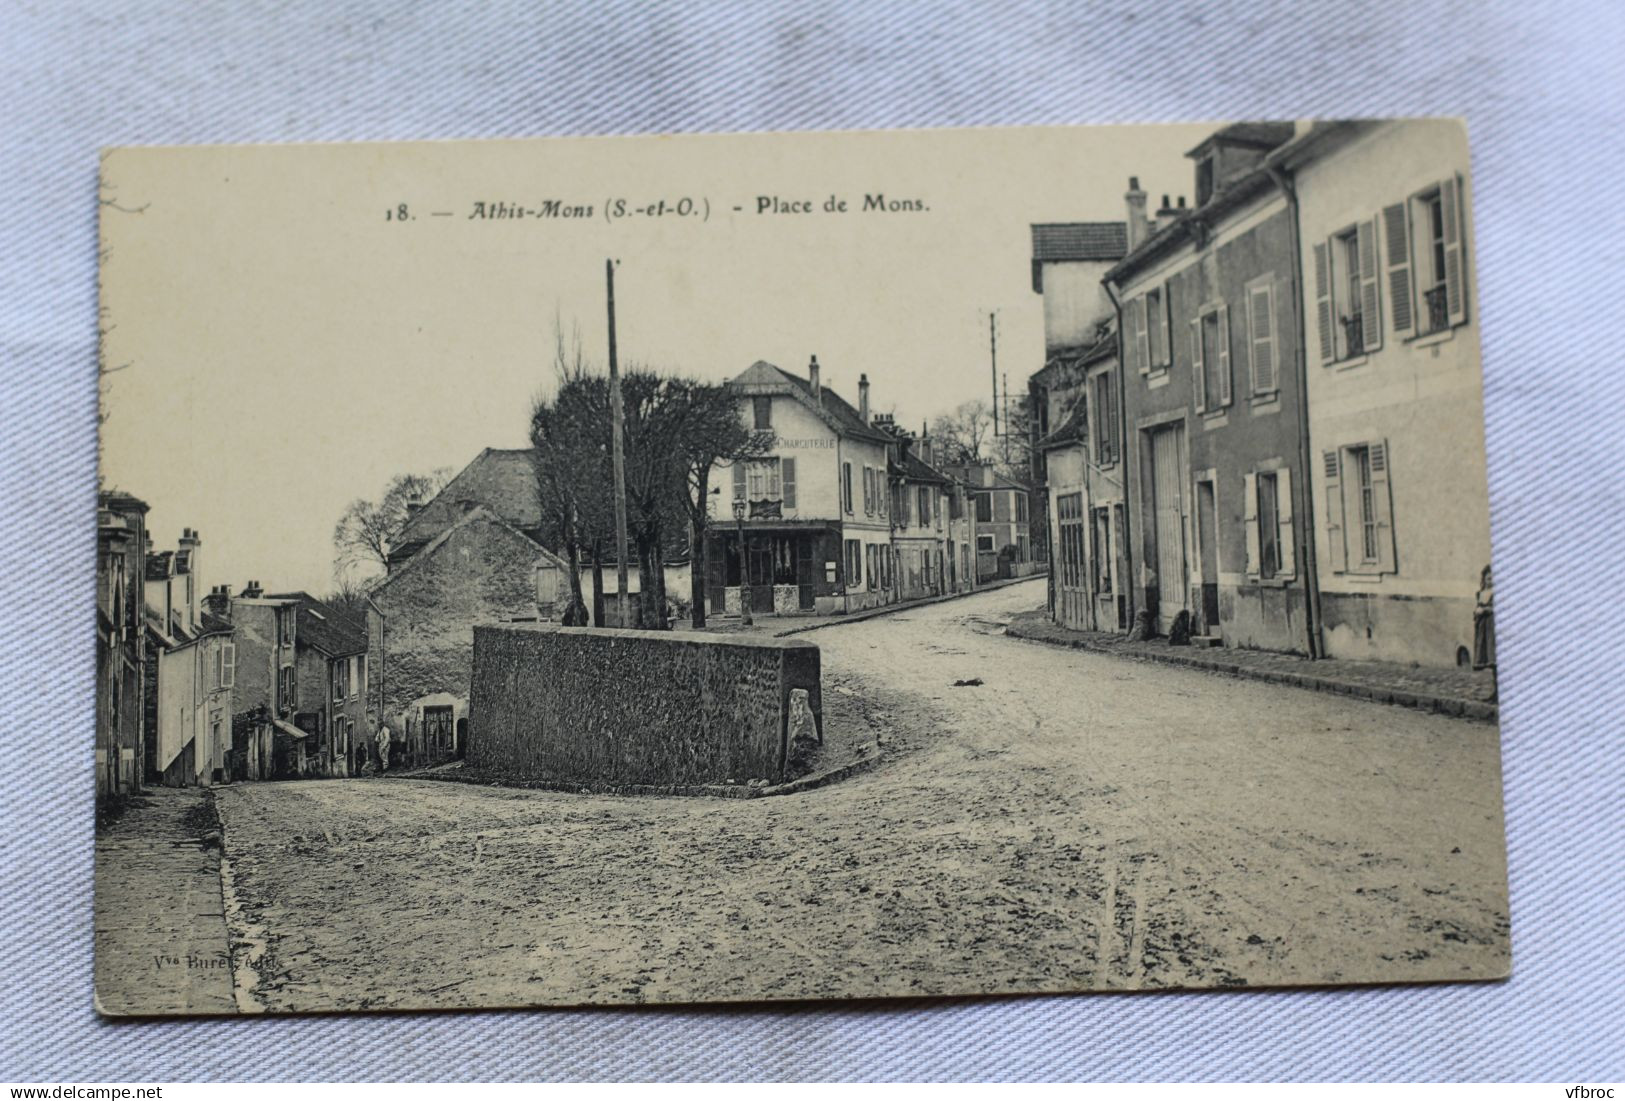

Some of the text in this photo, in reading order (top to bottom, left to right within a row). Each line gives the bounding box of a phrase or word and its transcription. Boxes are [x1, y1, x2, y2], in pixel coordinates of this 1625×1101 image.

[386, 203, 417, 222] 18.
[468, 201, 595, 220] Athis-Mons
[756, 195, 814, 215] Place
[823, 194, 849, 213] de
[862, 193, 931, 212] Mons.
[777, 437, 836, 449] CHARCUTERIE
